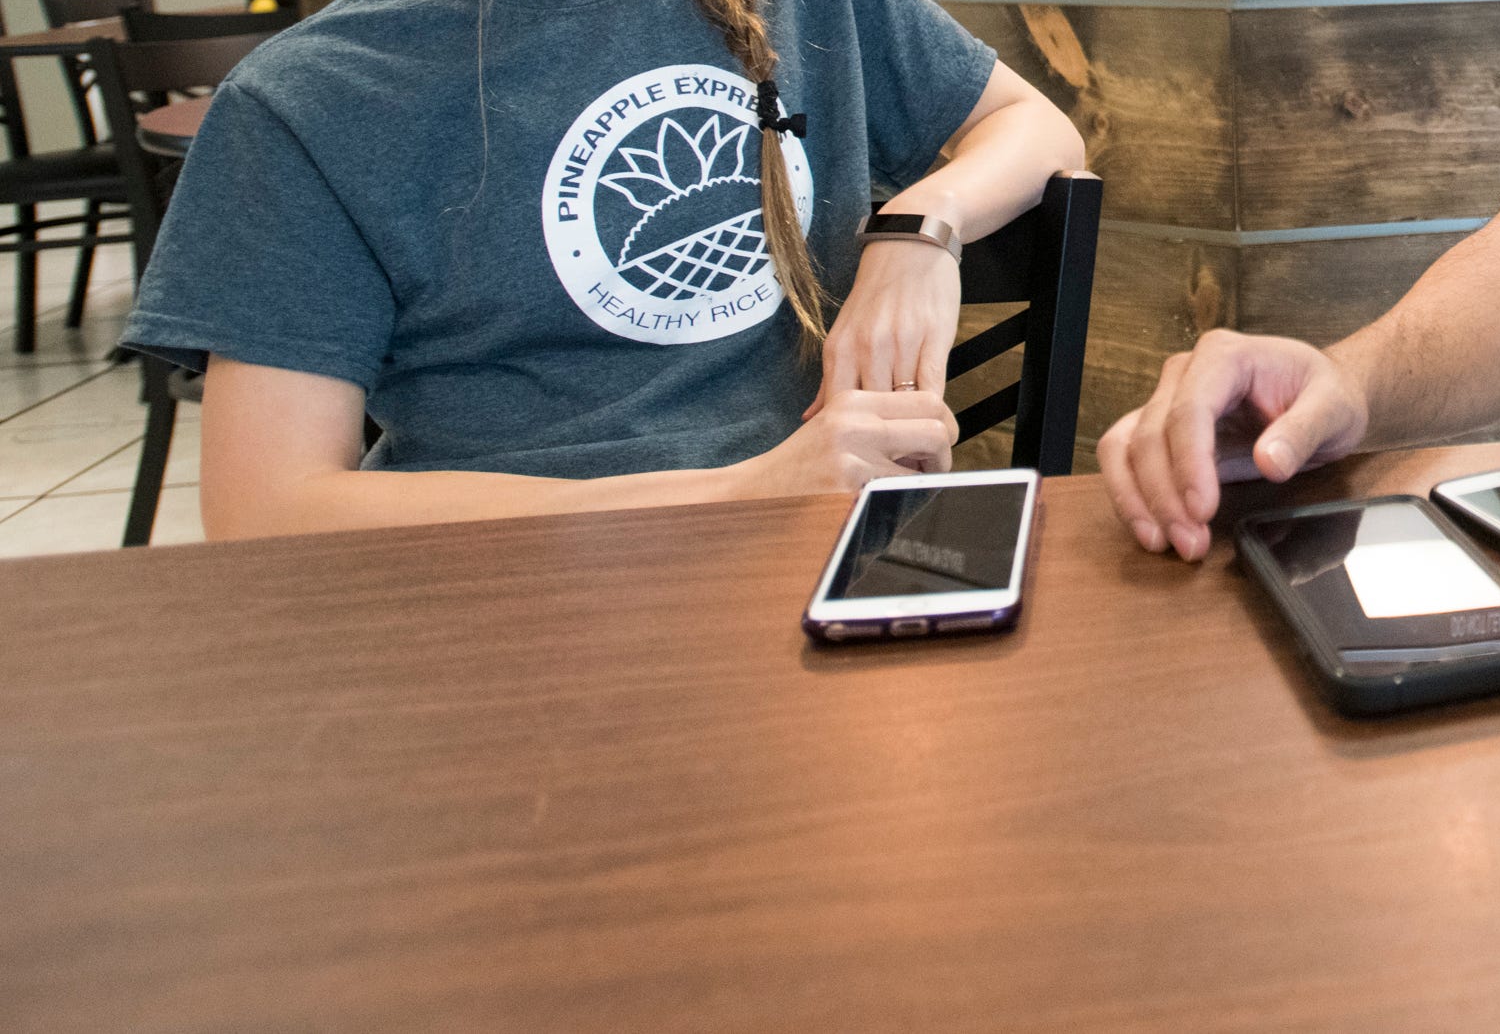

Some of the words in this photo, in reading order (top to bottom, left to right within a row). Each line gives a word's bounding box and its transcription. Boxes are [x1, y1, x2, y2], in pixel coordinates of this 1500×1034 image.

[558, 83, 666, 223] PINEAPPLE
[673, 76, 768, 122] EXPRE
[587, 282, 700, 331] HEALTHY
[710, 284, 774, 322] RICE
